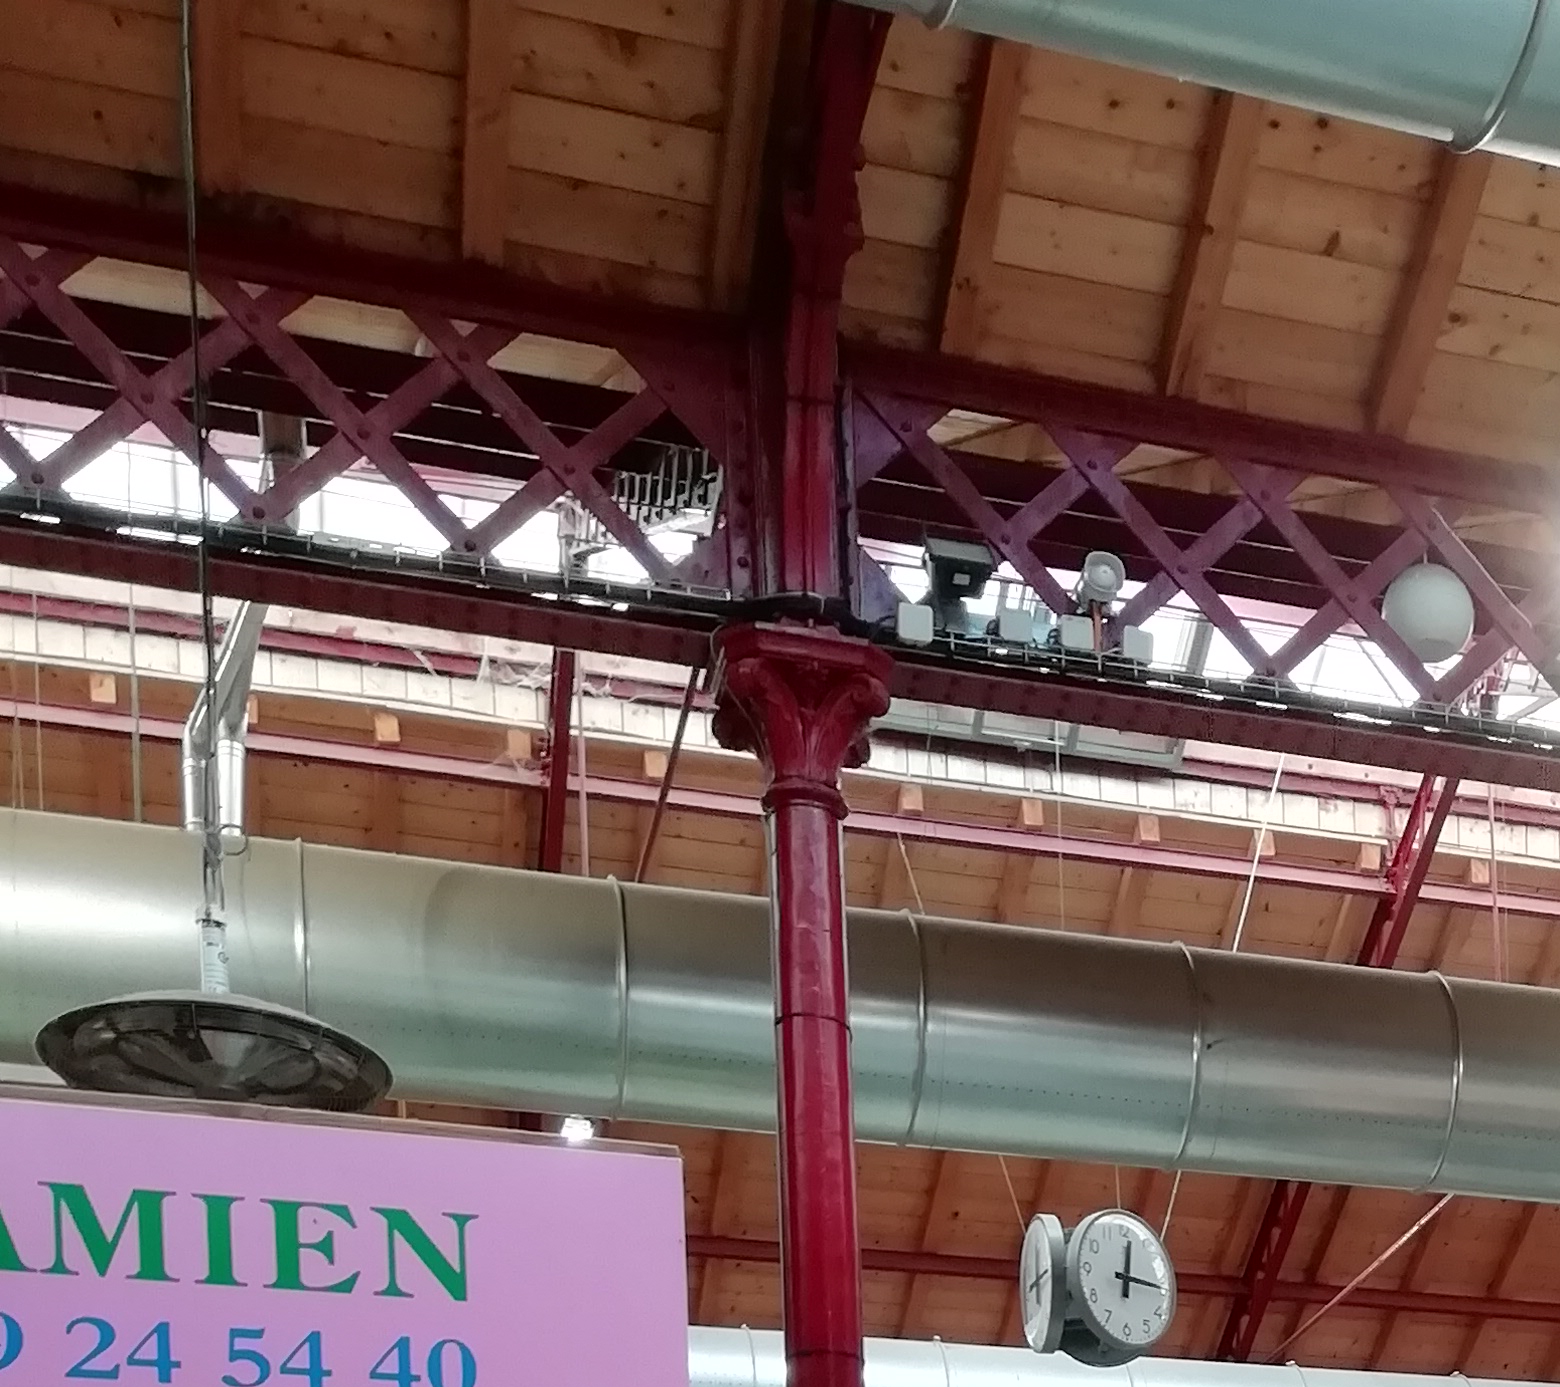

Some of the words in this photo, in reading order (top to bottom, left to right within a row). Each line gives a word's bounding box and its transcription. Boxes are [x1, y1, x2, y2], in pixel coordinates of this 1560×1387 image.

[1089, 1239, 1100, 1254] 10
[1083, 1261, 1092, 1276] 9
[1089, 1288, 1098, 1303] 8
[1104, 1309, 1113, 1323] 7
[1122, 1324, 1131, 1337] 6
[1143, 1319, 1151, 1333] 5
[64, 1316, 181, 1384] 24
